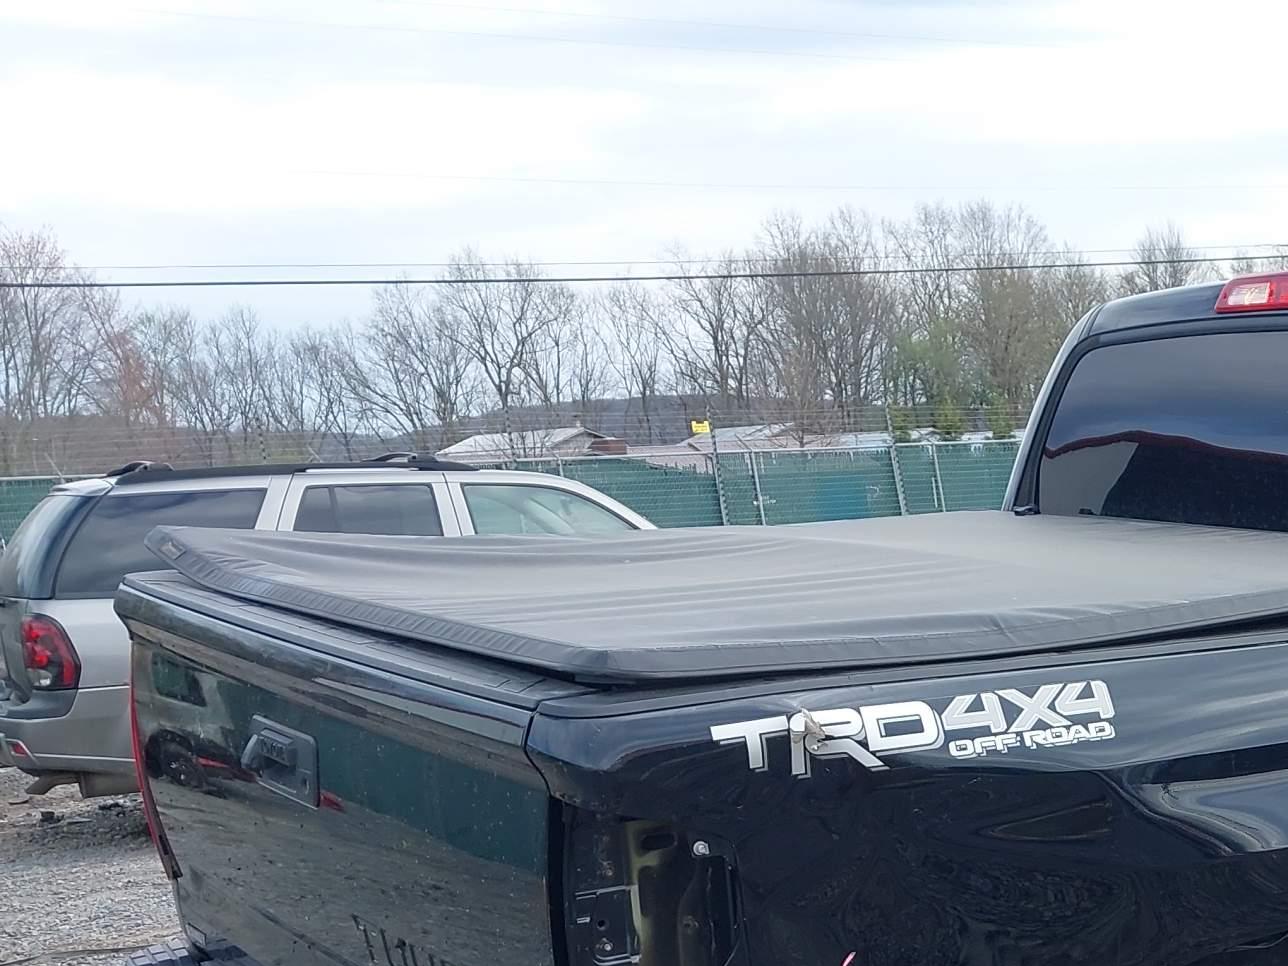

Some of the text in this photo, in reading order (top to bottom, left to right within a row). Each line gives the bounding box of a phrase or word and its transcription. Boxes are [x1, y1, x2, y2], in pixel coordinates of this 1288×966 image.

[709, 700, 945, 779] TRD
[948, 721, 1116, 760] OFF ROAD
